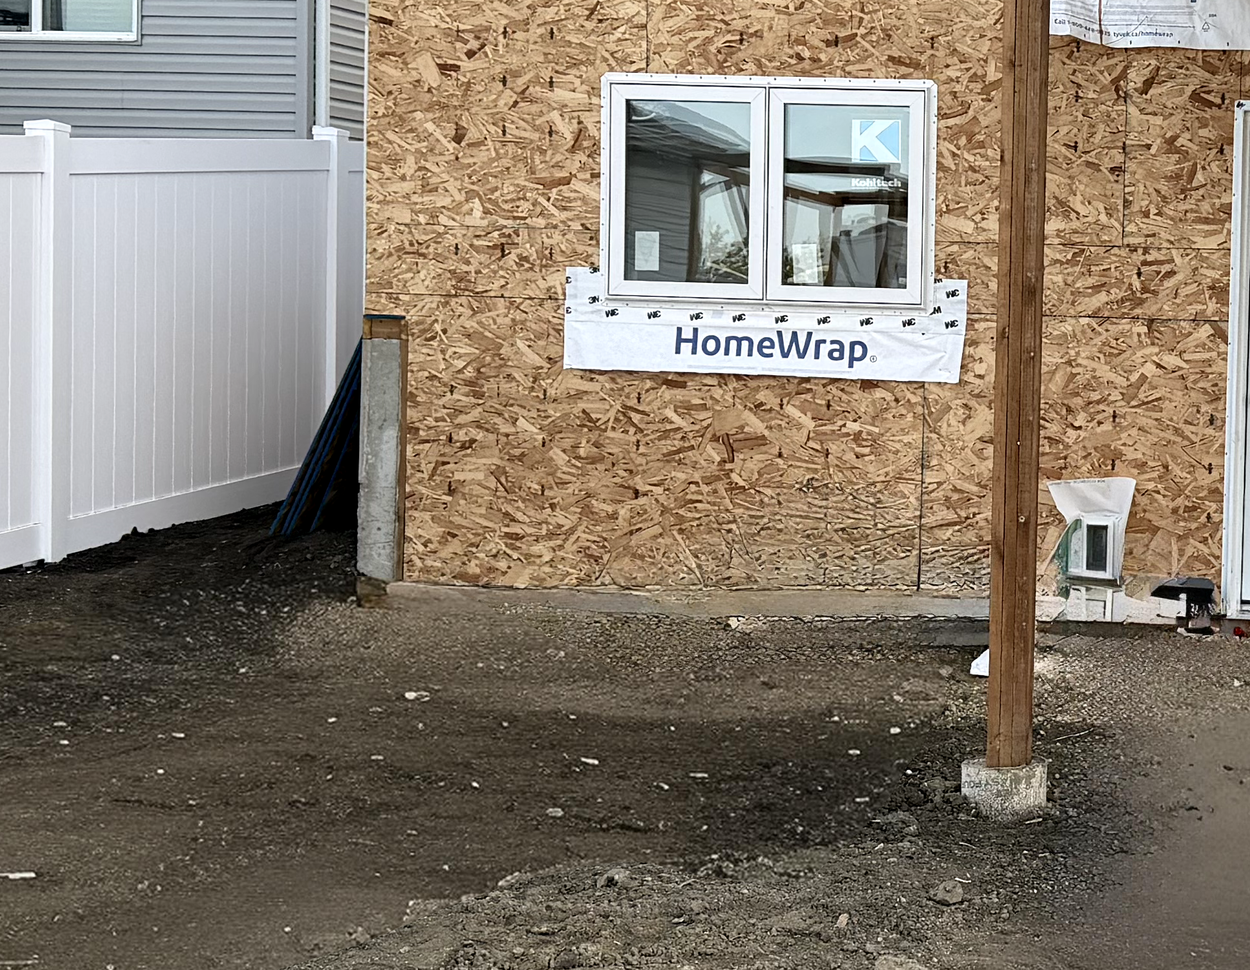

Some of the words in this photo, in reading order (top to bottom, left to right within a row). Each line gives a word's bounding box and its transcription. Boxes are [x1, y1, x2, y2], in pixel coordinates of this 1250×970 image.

[1054, 18, 1066, 26] Call
[851, 177, 902, 189] Kohltech
[945, 288, 960, 299] 3M
[605, 308, 619, 318] 3M
[647, 310, 662, 320] 3M
[689, 312, 704, 322] 3M
[732, 313, 746, 323] 3M
[774, 314, 789, 325] 3M
[816, 316, 831, 326] 3M
[859, 317, 874, 327] 3M
[901, 318, 916, 328] 3M
[944, 319, 959, 330] 3M
[674, 326, 869, 369] HomeWrap
